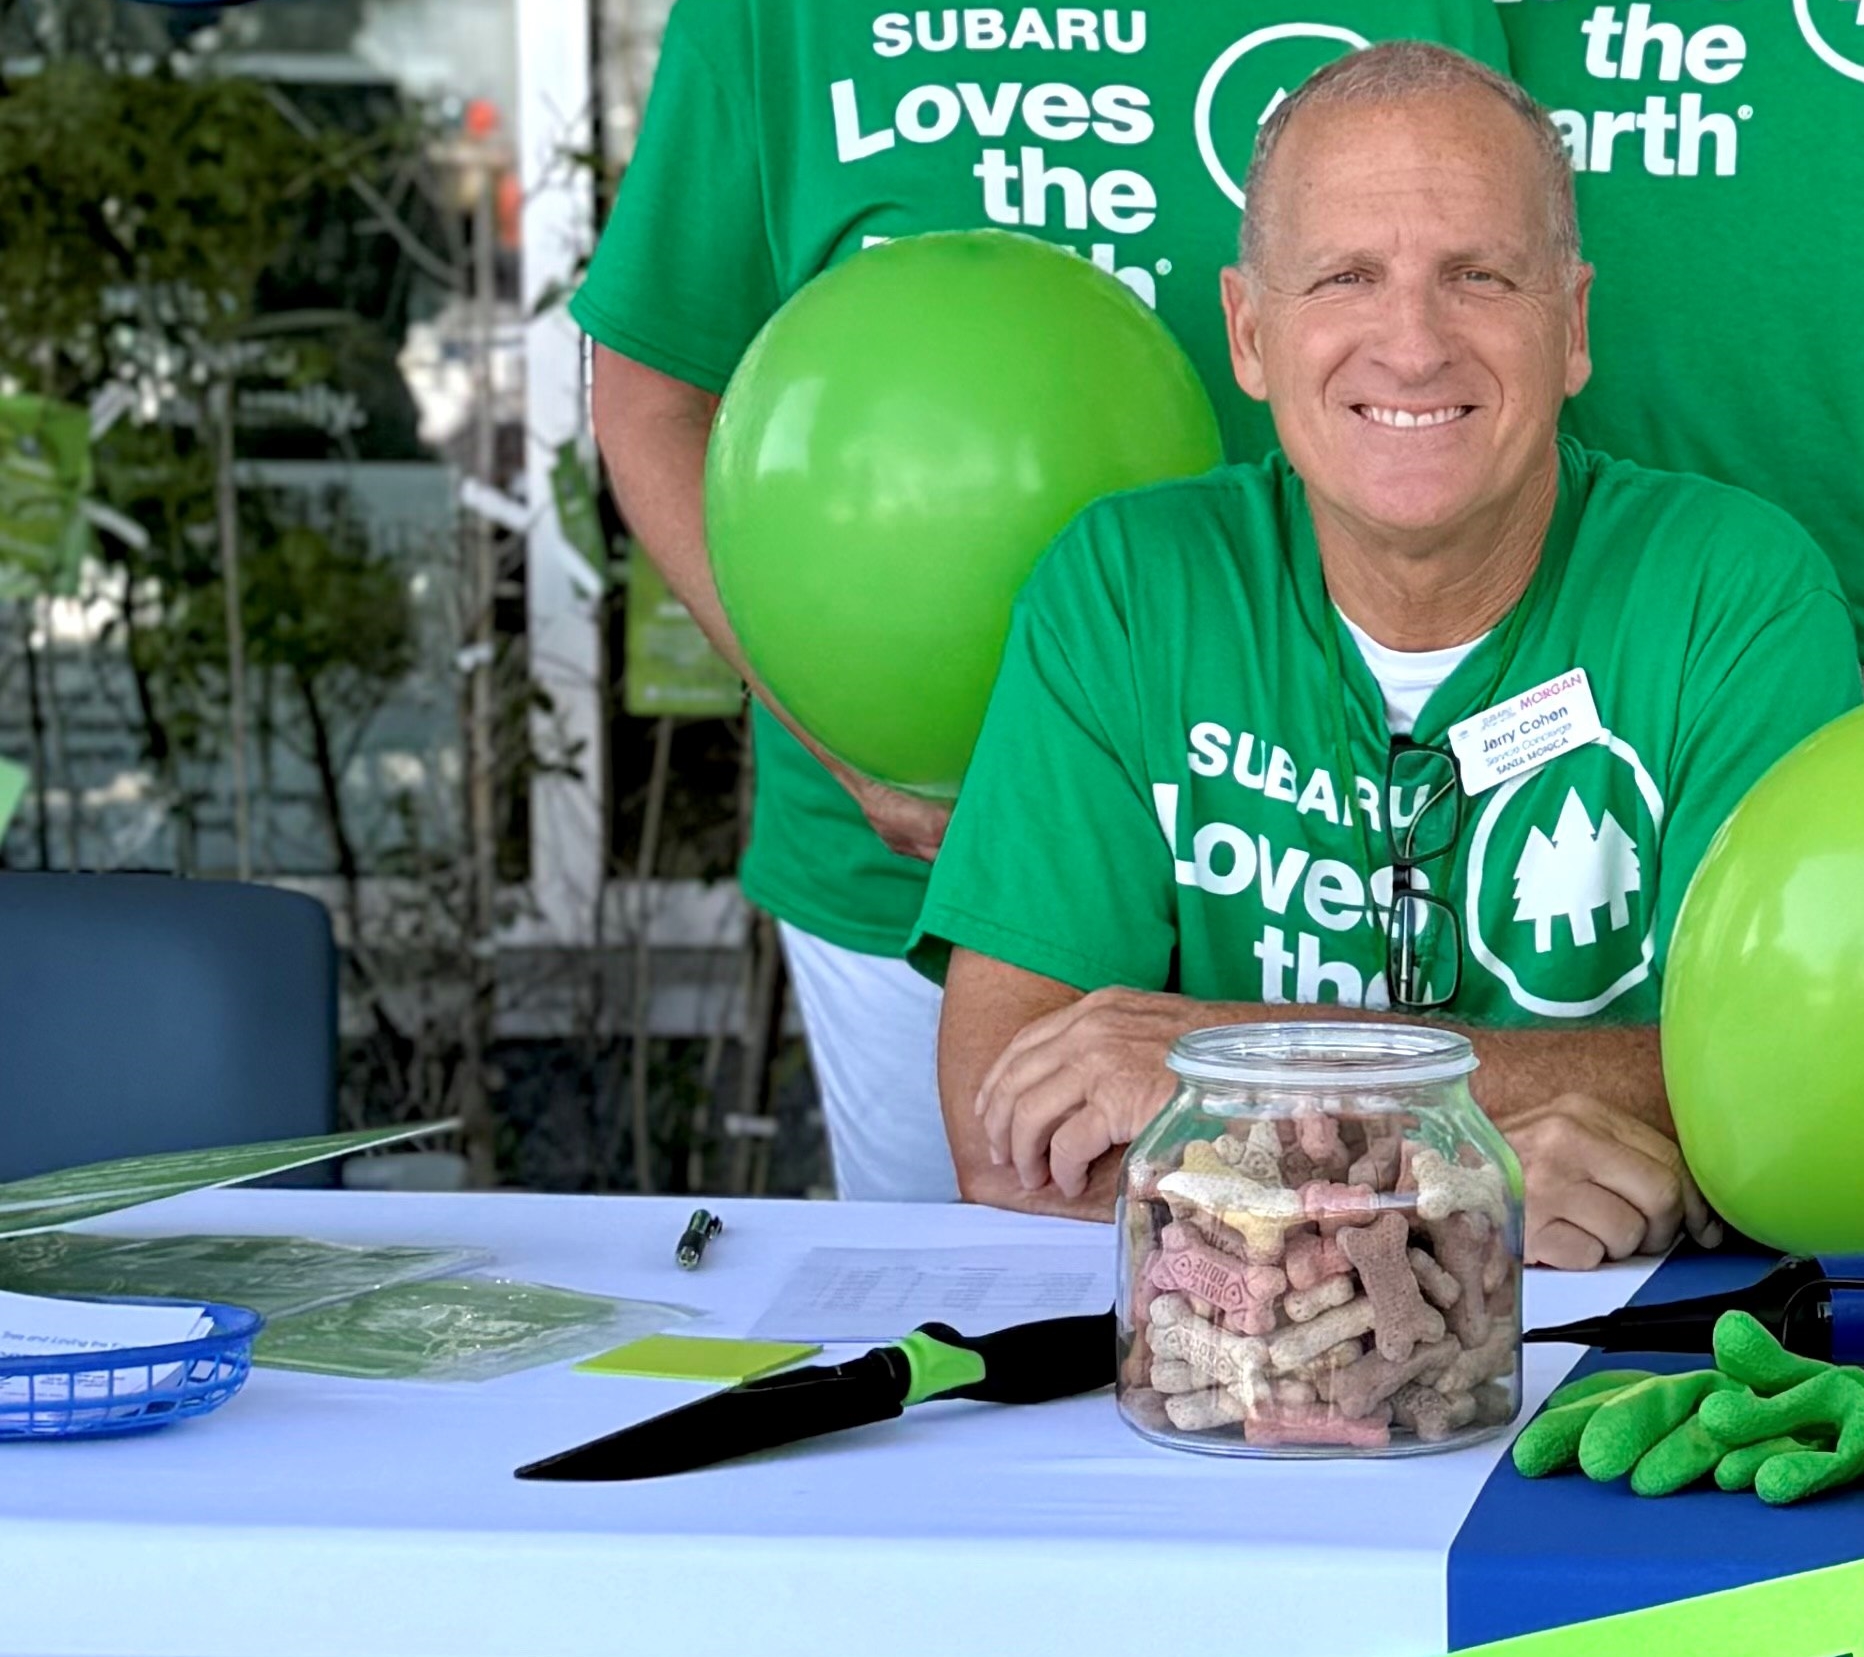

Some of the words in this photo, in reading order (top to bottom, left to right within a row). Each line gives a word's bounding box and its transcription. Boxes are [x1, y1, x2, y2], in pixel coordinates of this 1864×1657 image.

[872, 8, 1147, 57] SUBARU
[1581, 4, 1747, 85] the
[830, 79, 1155, 163] Loves
[973, 146, 1157, 234] the
[1482, 729, 1515, 753] Jerry
[1519, 706, 1568, 735] Cohen
[1519, 673, 1582, 711] MORGAN
[1188, 722, 1431, 832] SUBARU
[1152, 782, 1430, 935] Loves
